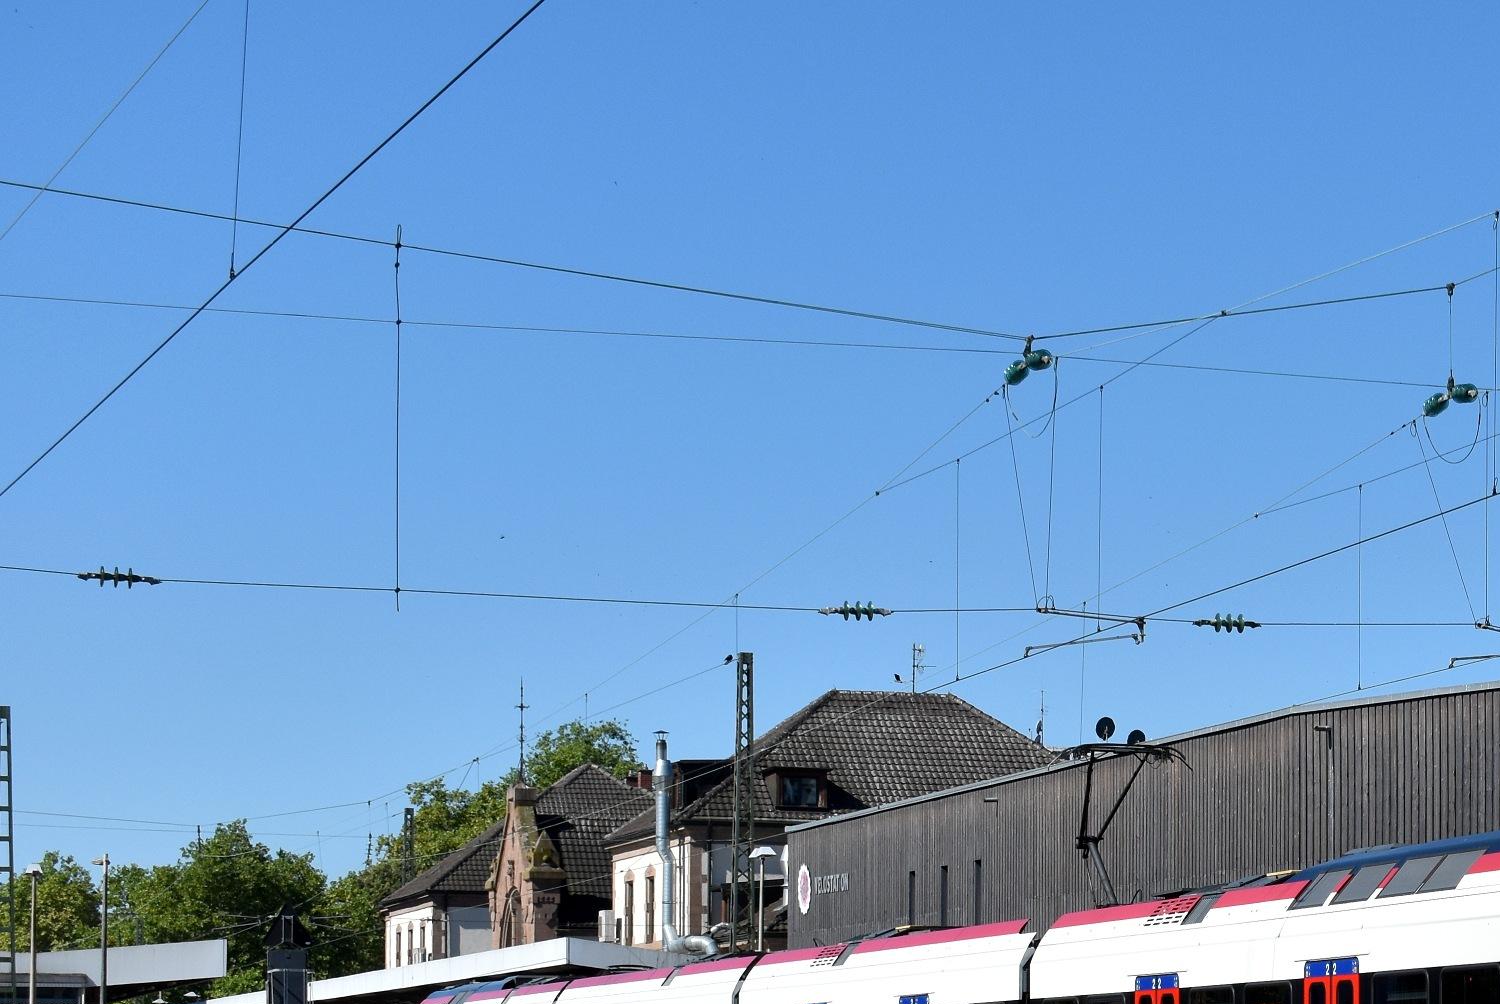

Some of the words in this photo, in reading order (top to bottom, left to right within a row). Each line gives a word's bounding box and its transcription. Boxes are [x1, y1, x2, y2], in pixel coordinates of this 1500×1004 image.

[814, 873, 849, 895] VELOSTATON
[1325, 963, 1330, 975] 2
[1332, 962, 1337, 975] 2
